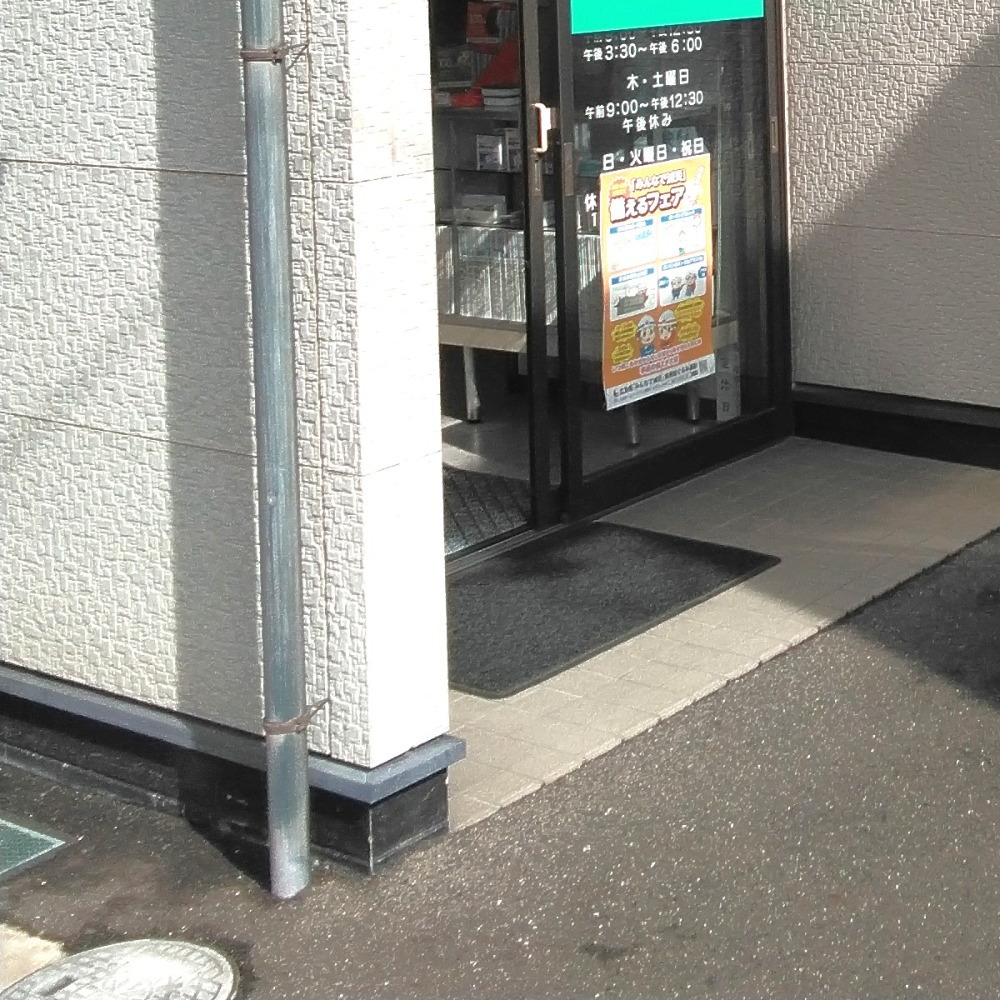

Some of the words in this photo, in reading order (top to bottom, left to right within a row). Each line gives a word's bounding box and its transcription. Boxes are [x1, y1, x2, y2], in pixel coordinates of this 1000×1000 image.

[626, 68, 690, 91] 木・土曜日
[622, 112, 673, 134] 午後休み
